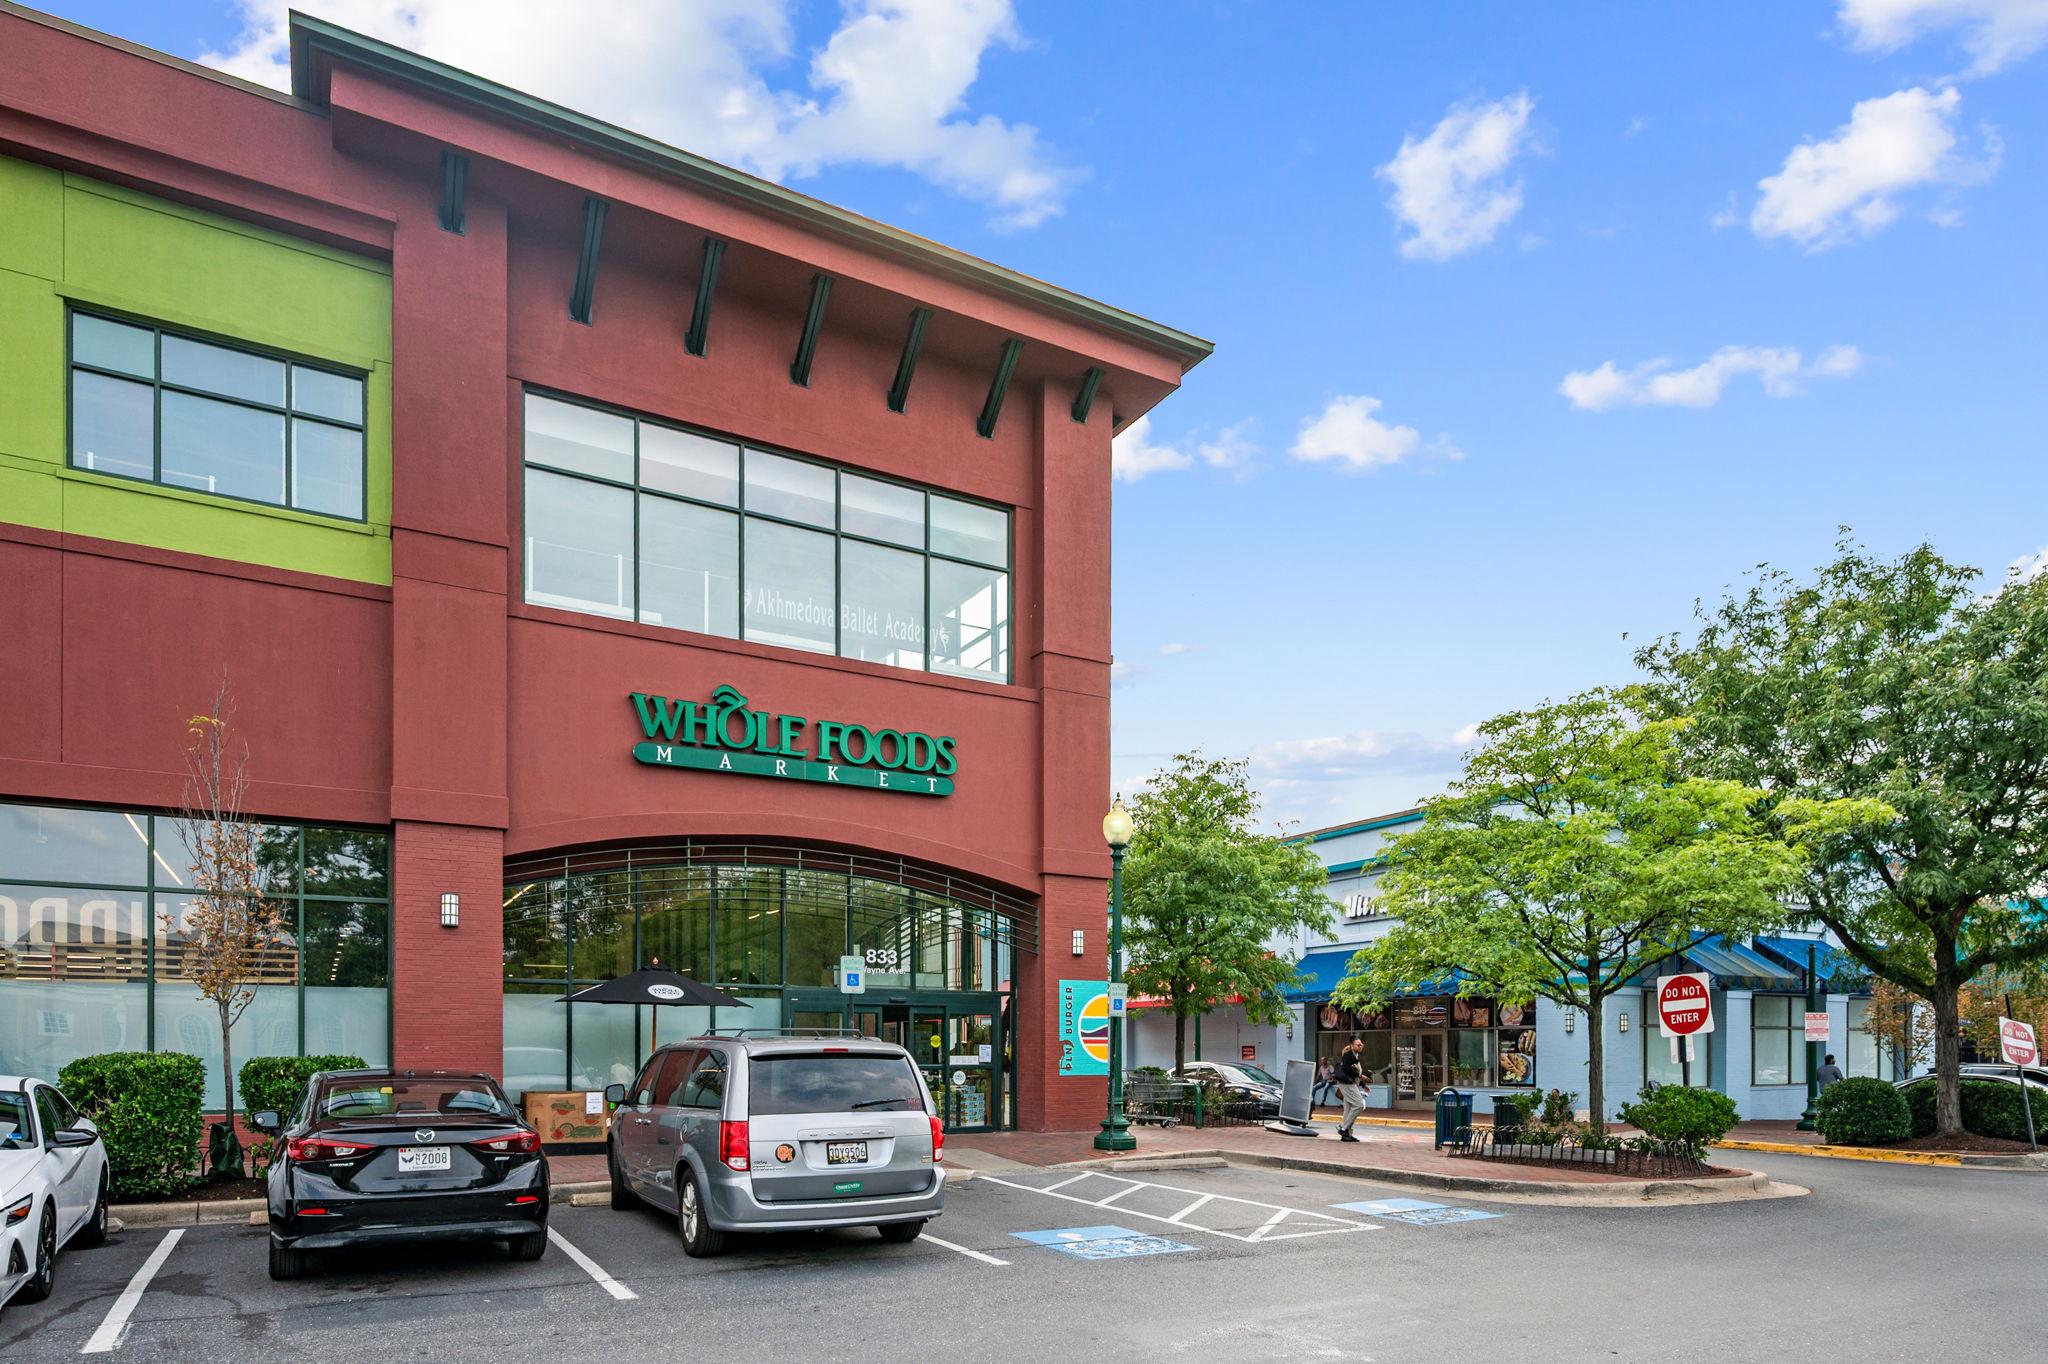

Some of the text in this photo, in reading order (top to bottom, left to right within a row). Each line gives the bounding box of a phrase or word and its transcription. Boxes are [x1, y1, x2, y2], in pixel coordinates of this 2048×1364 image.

[756, 586, 835, 628] Akhmedova
[841, 604, 878, 636] Ballet
[629, 684, 958, 777] WHOLE FOODS
[655, 745, 939, 793] MARKET
[866, 949, 898, 965] 833
[864, 965, 886, 976] ayne
[888, 966, 906, 975] Ave.
[1665, 985, 1701, 998] DO NOT
[1065, 987, 1073, 1034] BURGER
[1413, 1006, 1427, 1015] 819
[1671, 1012, 1700, 1024] ENTER
[2004, 1027, 2029, 1040] DO NOT
[2008, 1047, 2030, 1058] ENTER
[422, 1152, 448, 1165] 2008
[829, 1146, 866, 1159] 3DY9506
